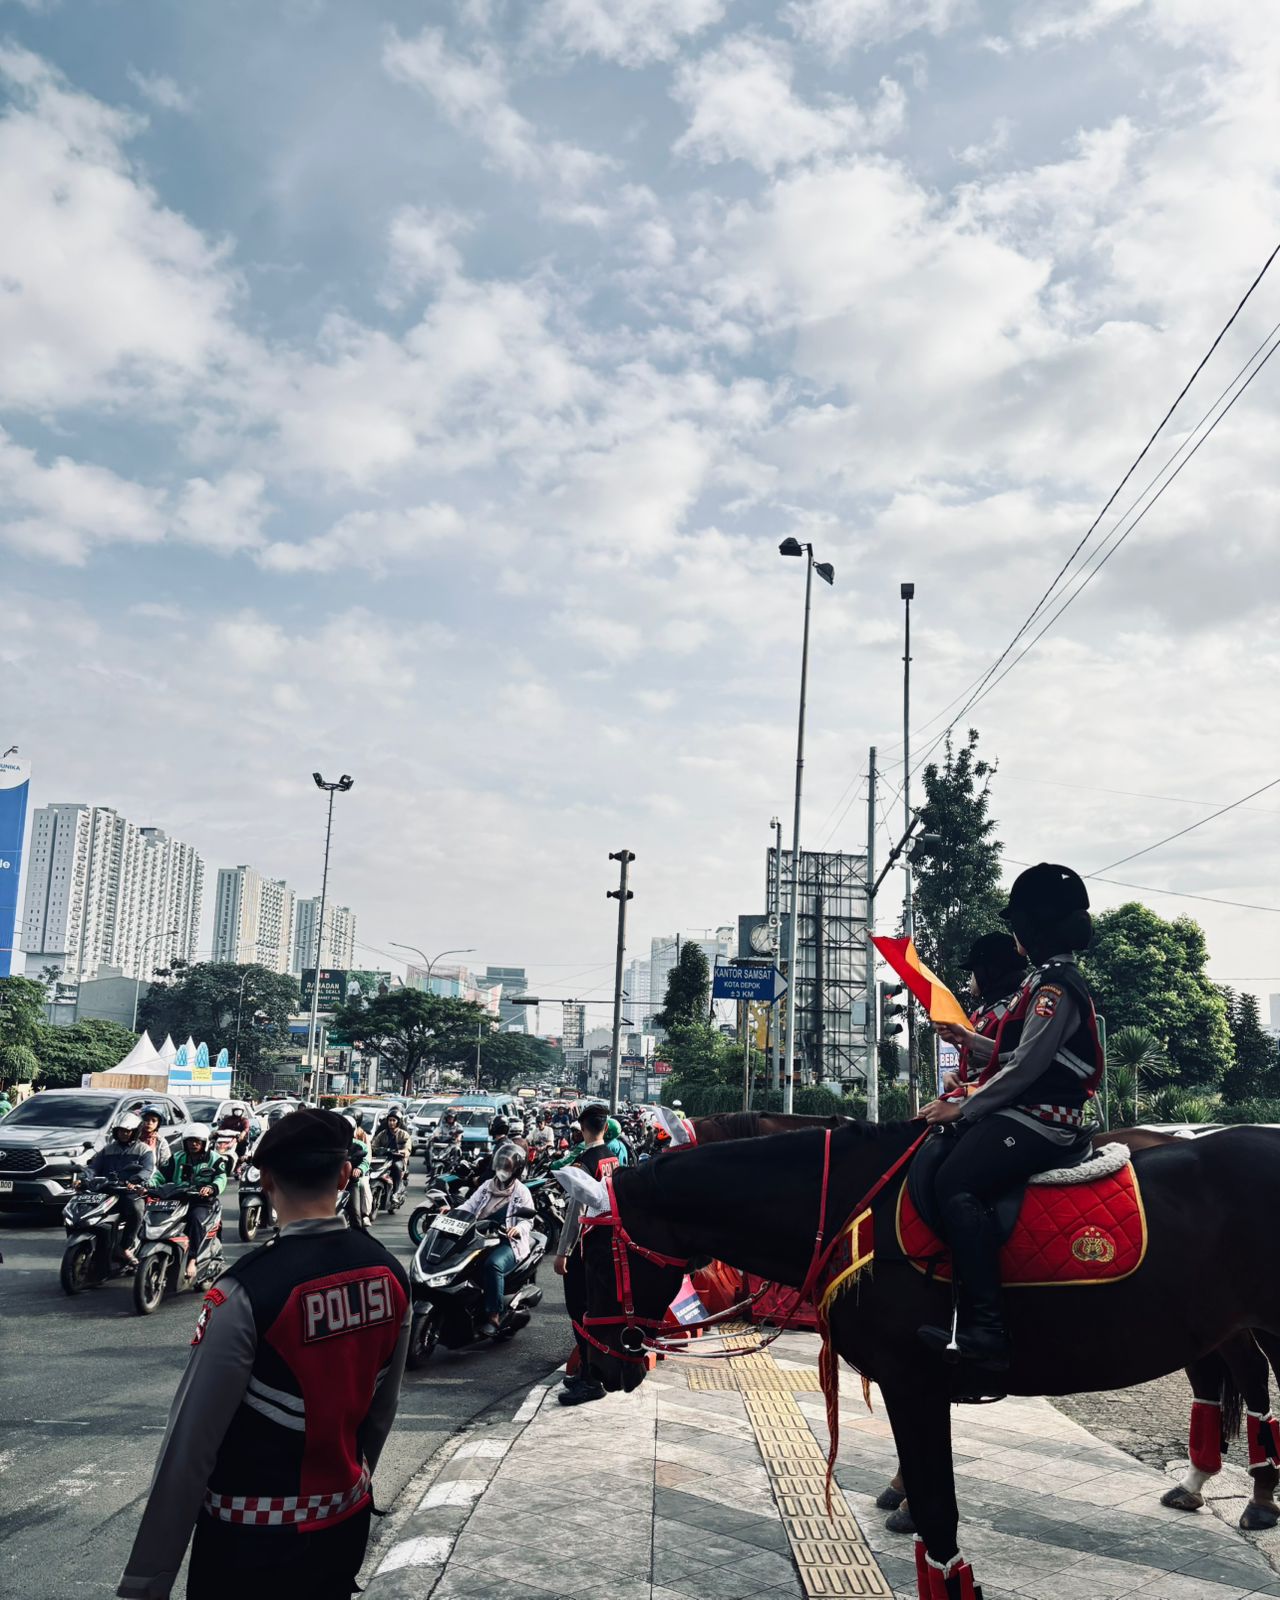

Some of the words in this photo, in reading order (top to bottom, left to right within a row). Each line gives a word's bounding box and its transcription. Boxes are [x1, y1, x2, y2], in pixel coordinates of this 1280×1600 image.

[714, 968, 742, 979] KANTOR
[743, 969, 772, 980] SAMSAT
[724, 981, 740, 989] KOTA
[740, 981, 761, 989] DEPOK
[305, 1276, 393, 1337] POLISI
